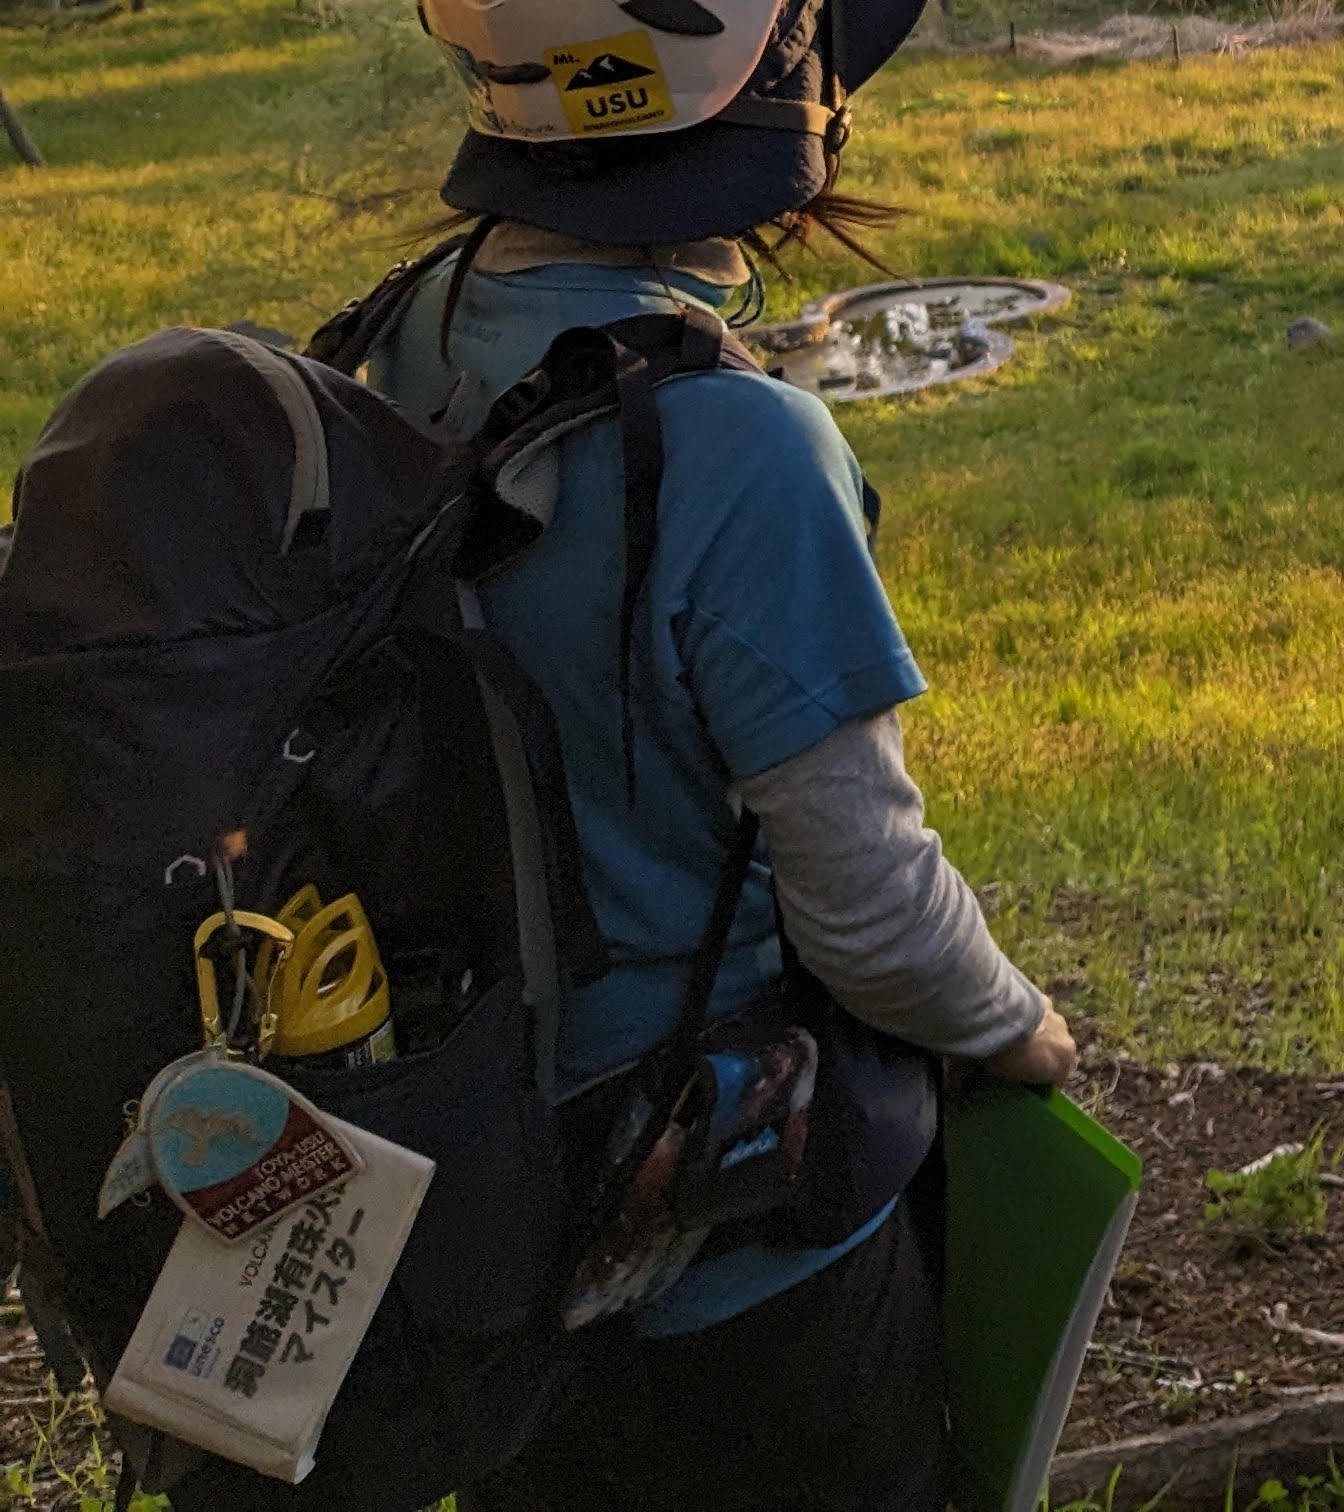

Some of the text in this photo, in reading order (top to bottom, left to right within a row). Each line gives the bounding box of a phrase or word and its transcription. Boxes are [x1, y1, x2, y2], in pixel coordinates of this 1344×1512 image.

[552, 53, 580, 65] Mt.
[585, 88, 649, 118] USU
[205, 1176, 281, 1227] VOLCANO
[223, 1184, 346, 1399] 洞爺湖有珠火
[279, 1207, 365, 1365] マイスター
